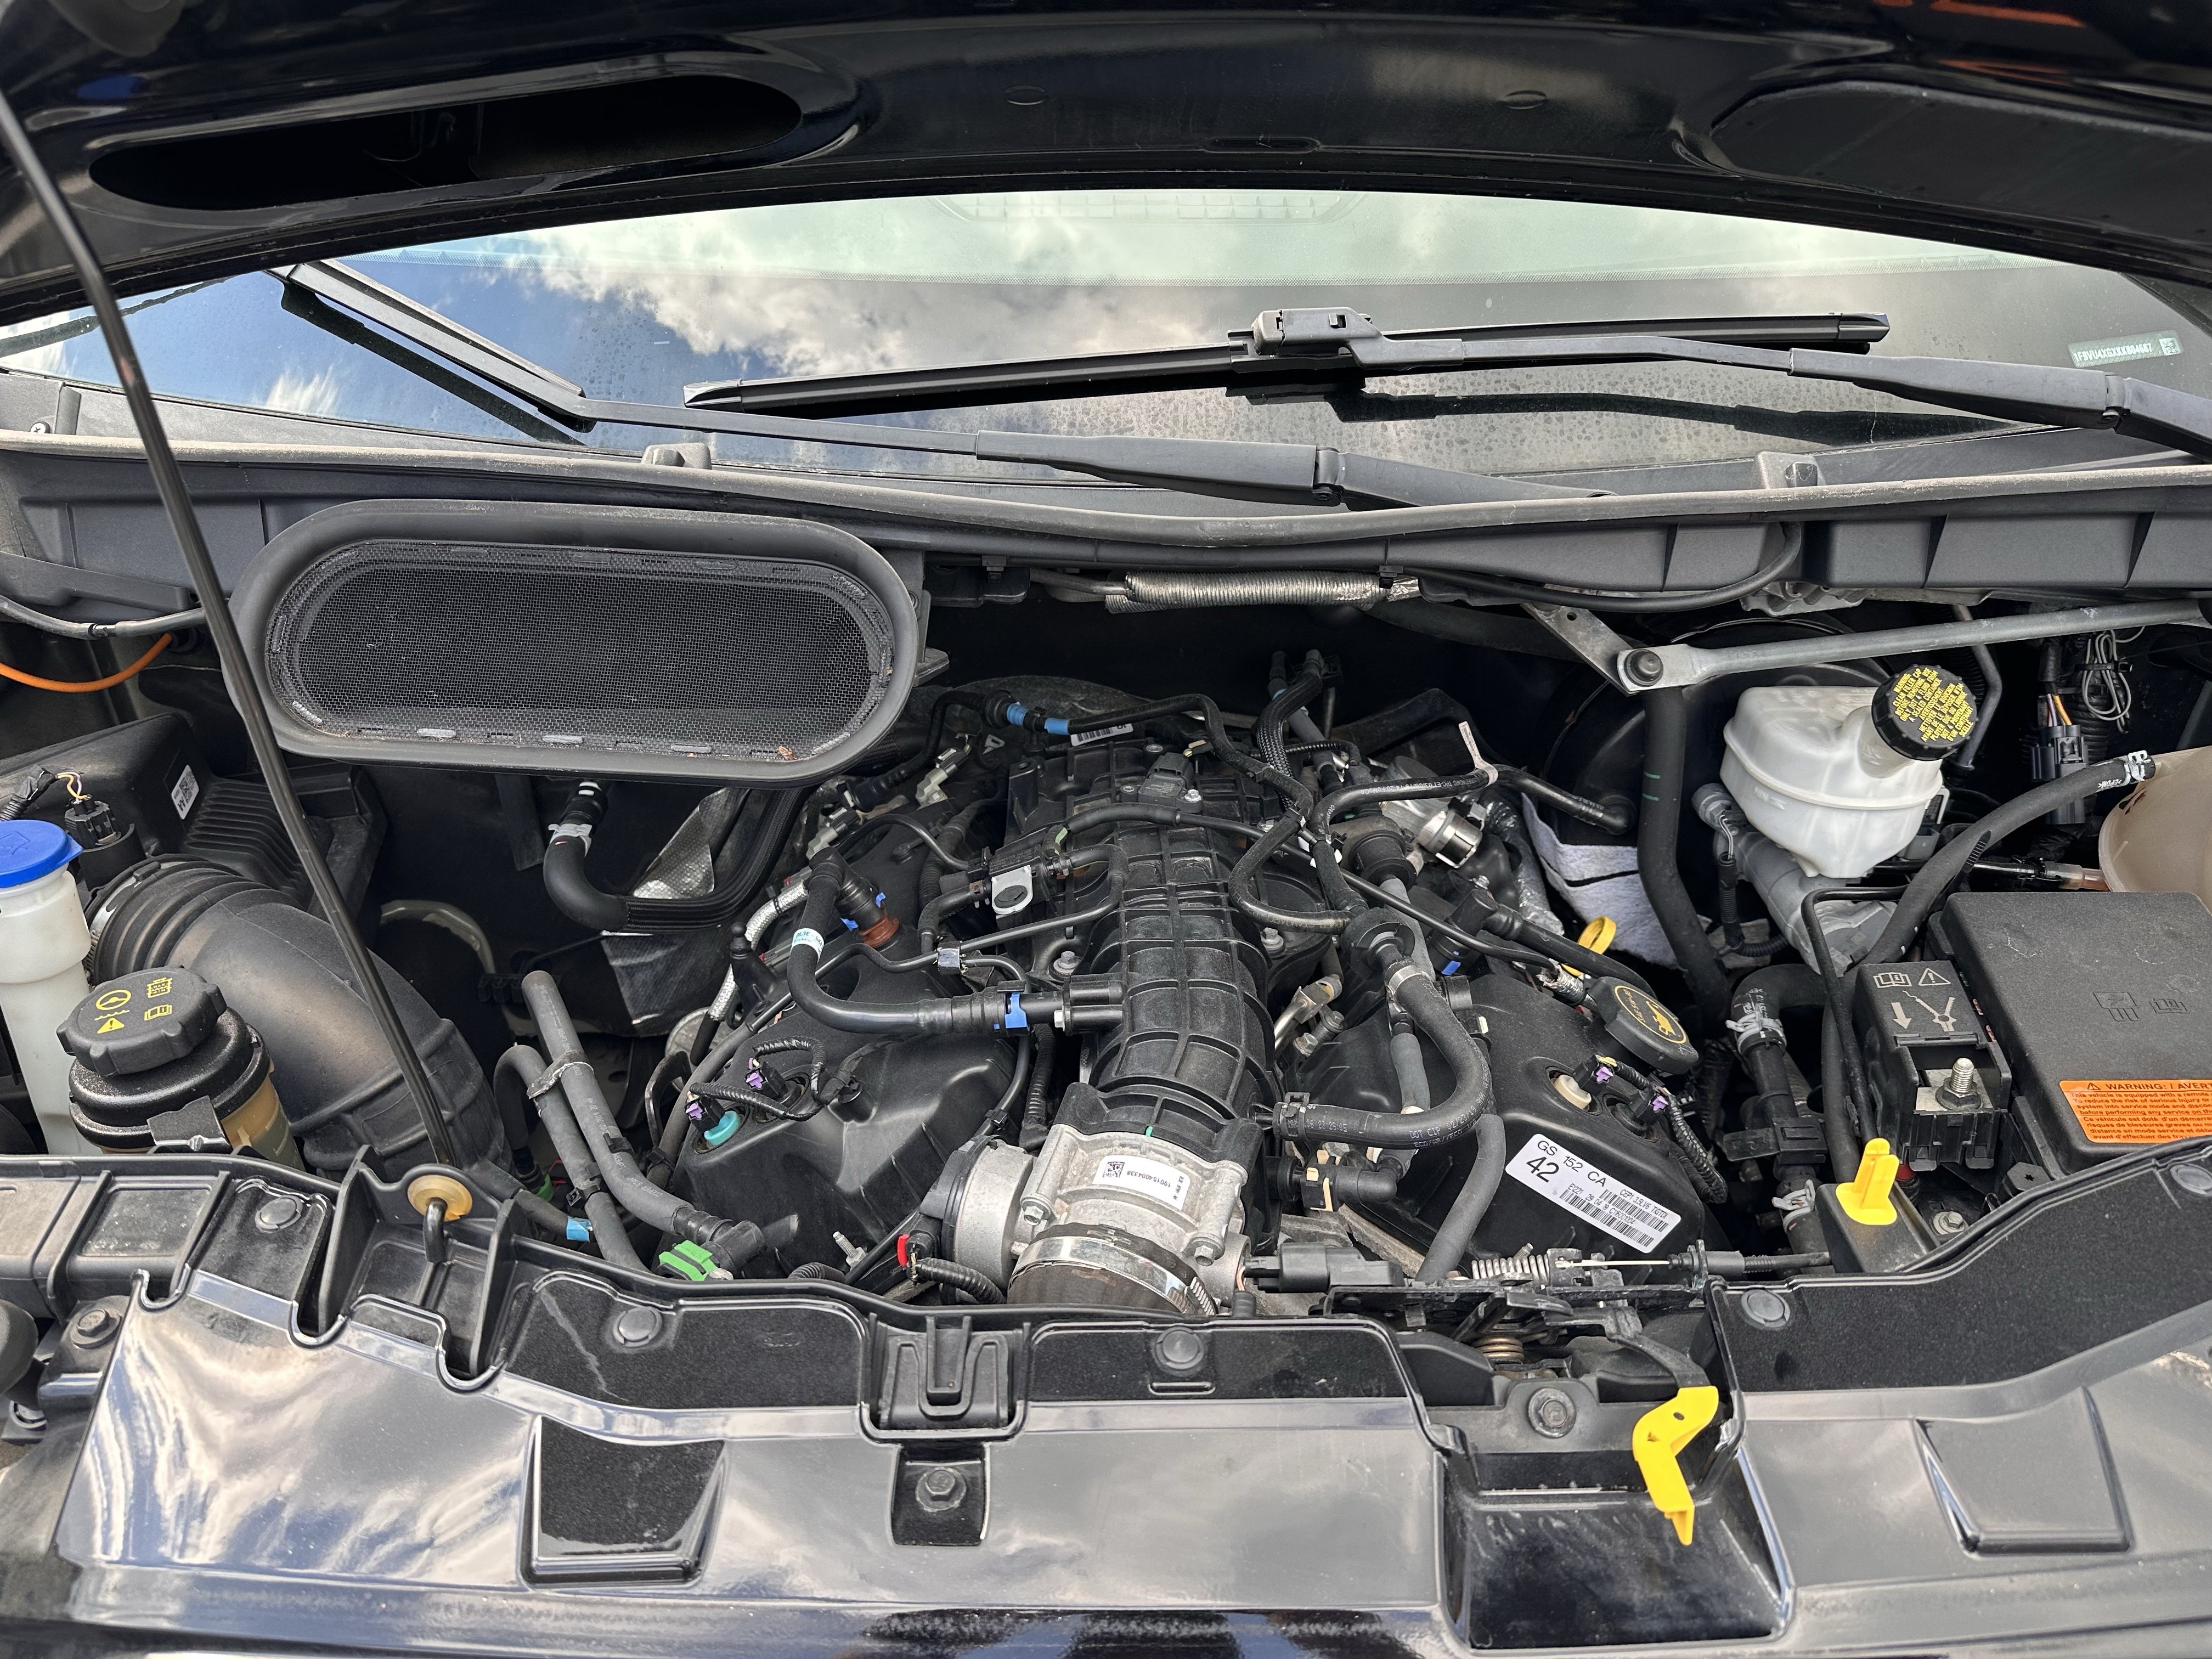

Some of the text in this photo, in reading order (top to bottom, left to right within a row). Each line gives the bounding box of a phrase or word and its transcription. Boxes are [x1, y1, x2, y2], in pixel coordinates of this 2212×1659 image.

[1893, 668, 1923, 707] CLEAN FILLER CAP
[1895, 698, 1910, 716] BEFORE
[1922, 667, 1932, 679] USE
[1900, 708, 1913, 723] ONLY
[1908, 699, 1920, 710] DOT
[1918, 682, 1932, 697] FLUID
[1927, 670, 1939, 684] FROM
[1918, 710, 1939, 732] NETTOYER
[1939, 683, 1957, 703] BOUCHON
[1909, 715, 1917, 723] A
[1912, 700, 1927, 718] SEALED
[1930, 690, 1968, 741] PLOYER QUE DU LIQUIDE
[1940, 728, 1951, 741] DOT
[1949, 700, 1970, 724] PROVENANT
[1955, 706, 1974, 730] CONTENANT
[1921, 726, 1936, 743] AVANT
[1930, 719, 1940, 729] DE
[1526, 1157, 1559, 1182] 42
[1538, 1141, 1606, 1187] GS 152 CA
